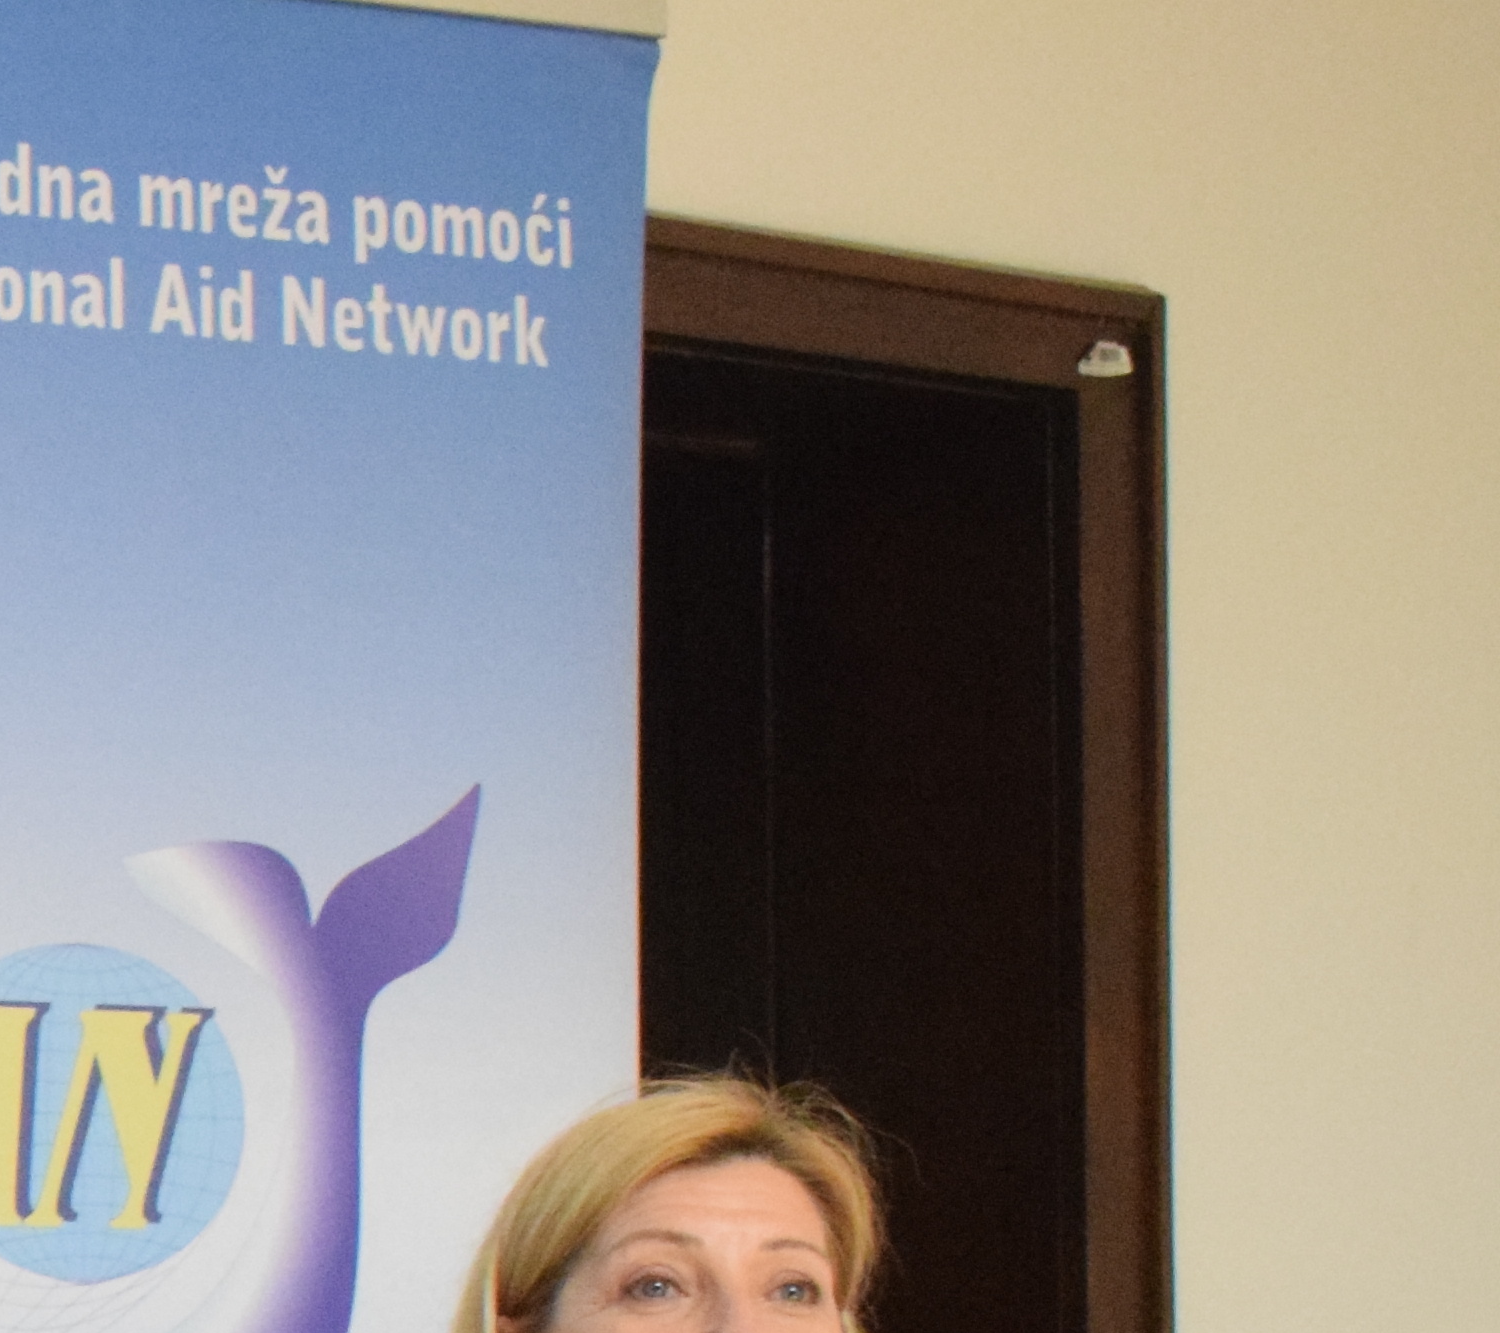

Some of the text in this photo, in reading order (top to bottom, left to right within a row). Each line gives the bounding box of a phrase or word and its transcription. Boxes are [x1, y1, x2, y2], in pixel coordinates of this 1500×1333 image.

[139, 164, 330, 246] mreža
[352, 193, 573, 269] pomoći
[149, 262, 255, 343] Aid
[282, 275, 549, 368] Network
